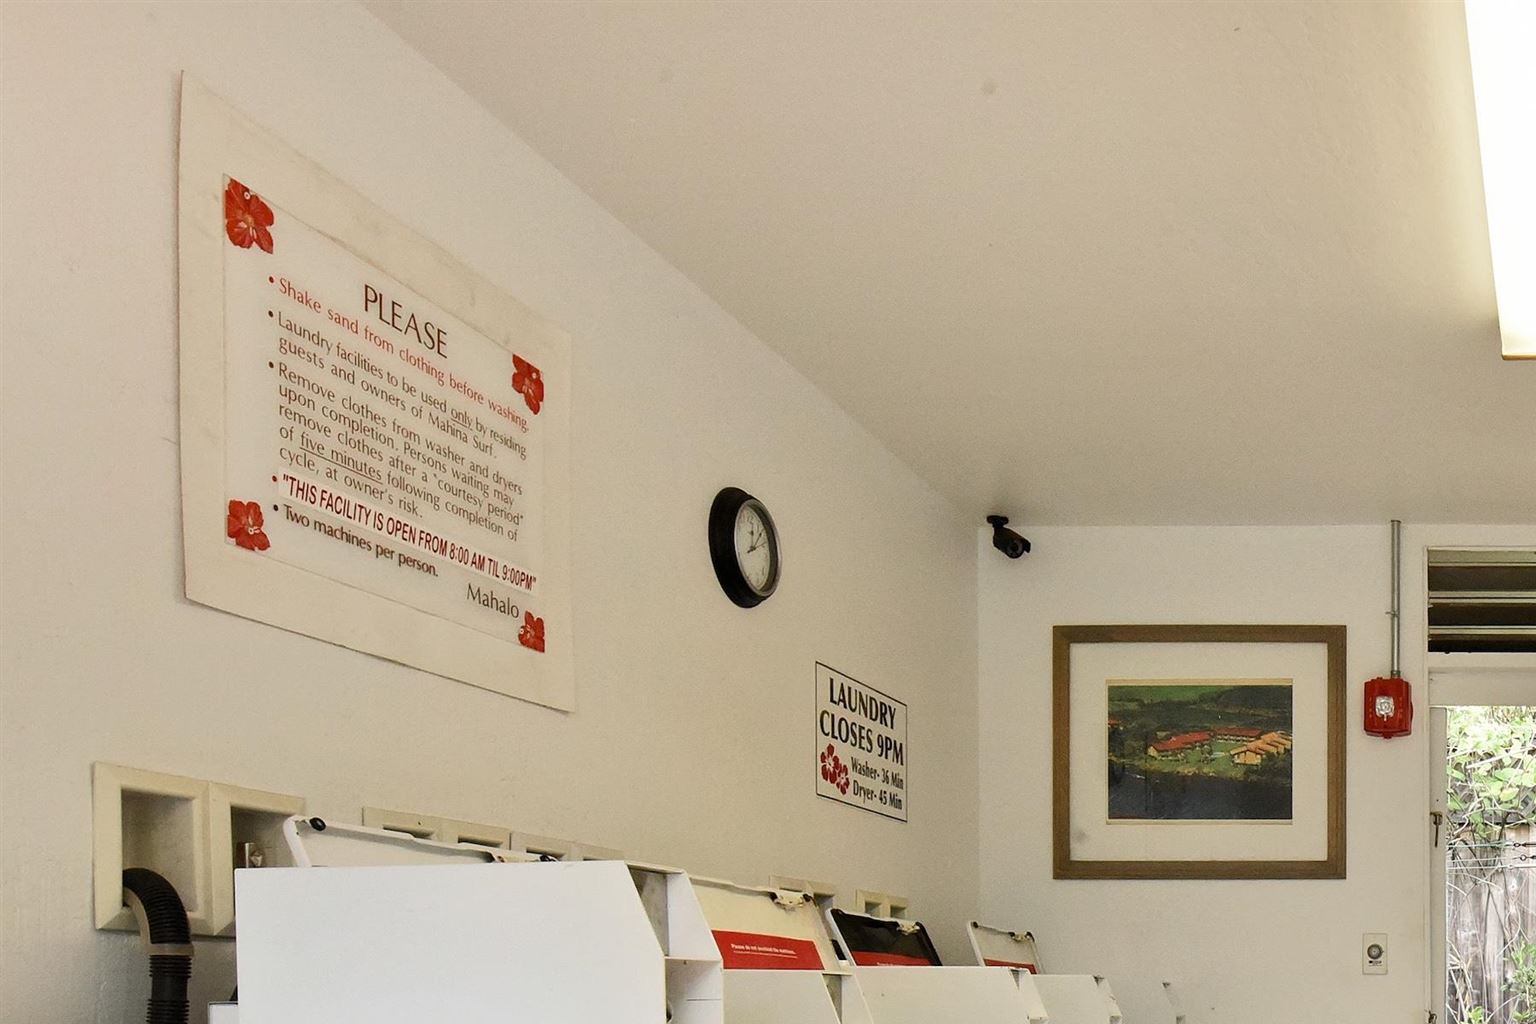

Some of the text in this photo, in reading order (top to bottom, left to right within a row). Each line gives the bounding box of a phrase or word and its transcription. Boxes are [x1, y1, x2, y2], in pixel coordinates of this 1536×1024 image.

[279, 277, 529, 433] Shake sand from clothing before washing.
[364, 284, 447, 359] PLEASE
[278, 311, 527, 461] Laundry facilities to be used only by residing
[279, 337, 497, 459] guests and owners of Mahina Surf.
[279, 362, 523, 496] Remove clothes from washer and dryers
[279, 404, 331, 438] remove
[337, 431, 384, 462] clothes
[389, 454, 416, 477] after
[421, 471, 428, 483] a
[279, 384, 514, 509] upon completion. Persons waiting may
[279, 447, 423, 519] cycle, at owner's risk.
[279, 426, 518, 542] of five minutes following completion of
[283, 473, 318, 505] "THIS
[319, 489, 372, 526] FACILITY
[373, 510, 384, 532] IS
[386, 516, 417, 545] OPEN
[418, 529, 448, 557] FROM
[449, 542, 470, 566] 8:00
[470, 551, 486, 572] AM
[487, 558, 500, 579] TIL
[283, 503, 439, 577] Two machines per person.
[466, 582, 520, 619] Mahalo
[819, 709, 904, 766] CLOSES 9PM
[829, 677, 897, 730] LAUNDRY
[878, 789, 888, 806] 45
[889, 791, 903, 810] Min
[881, 768, 890, 785] 36
[891, 771, 904, 790] Min
